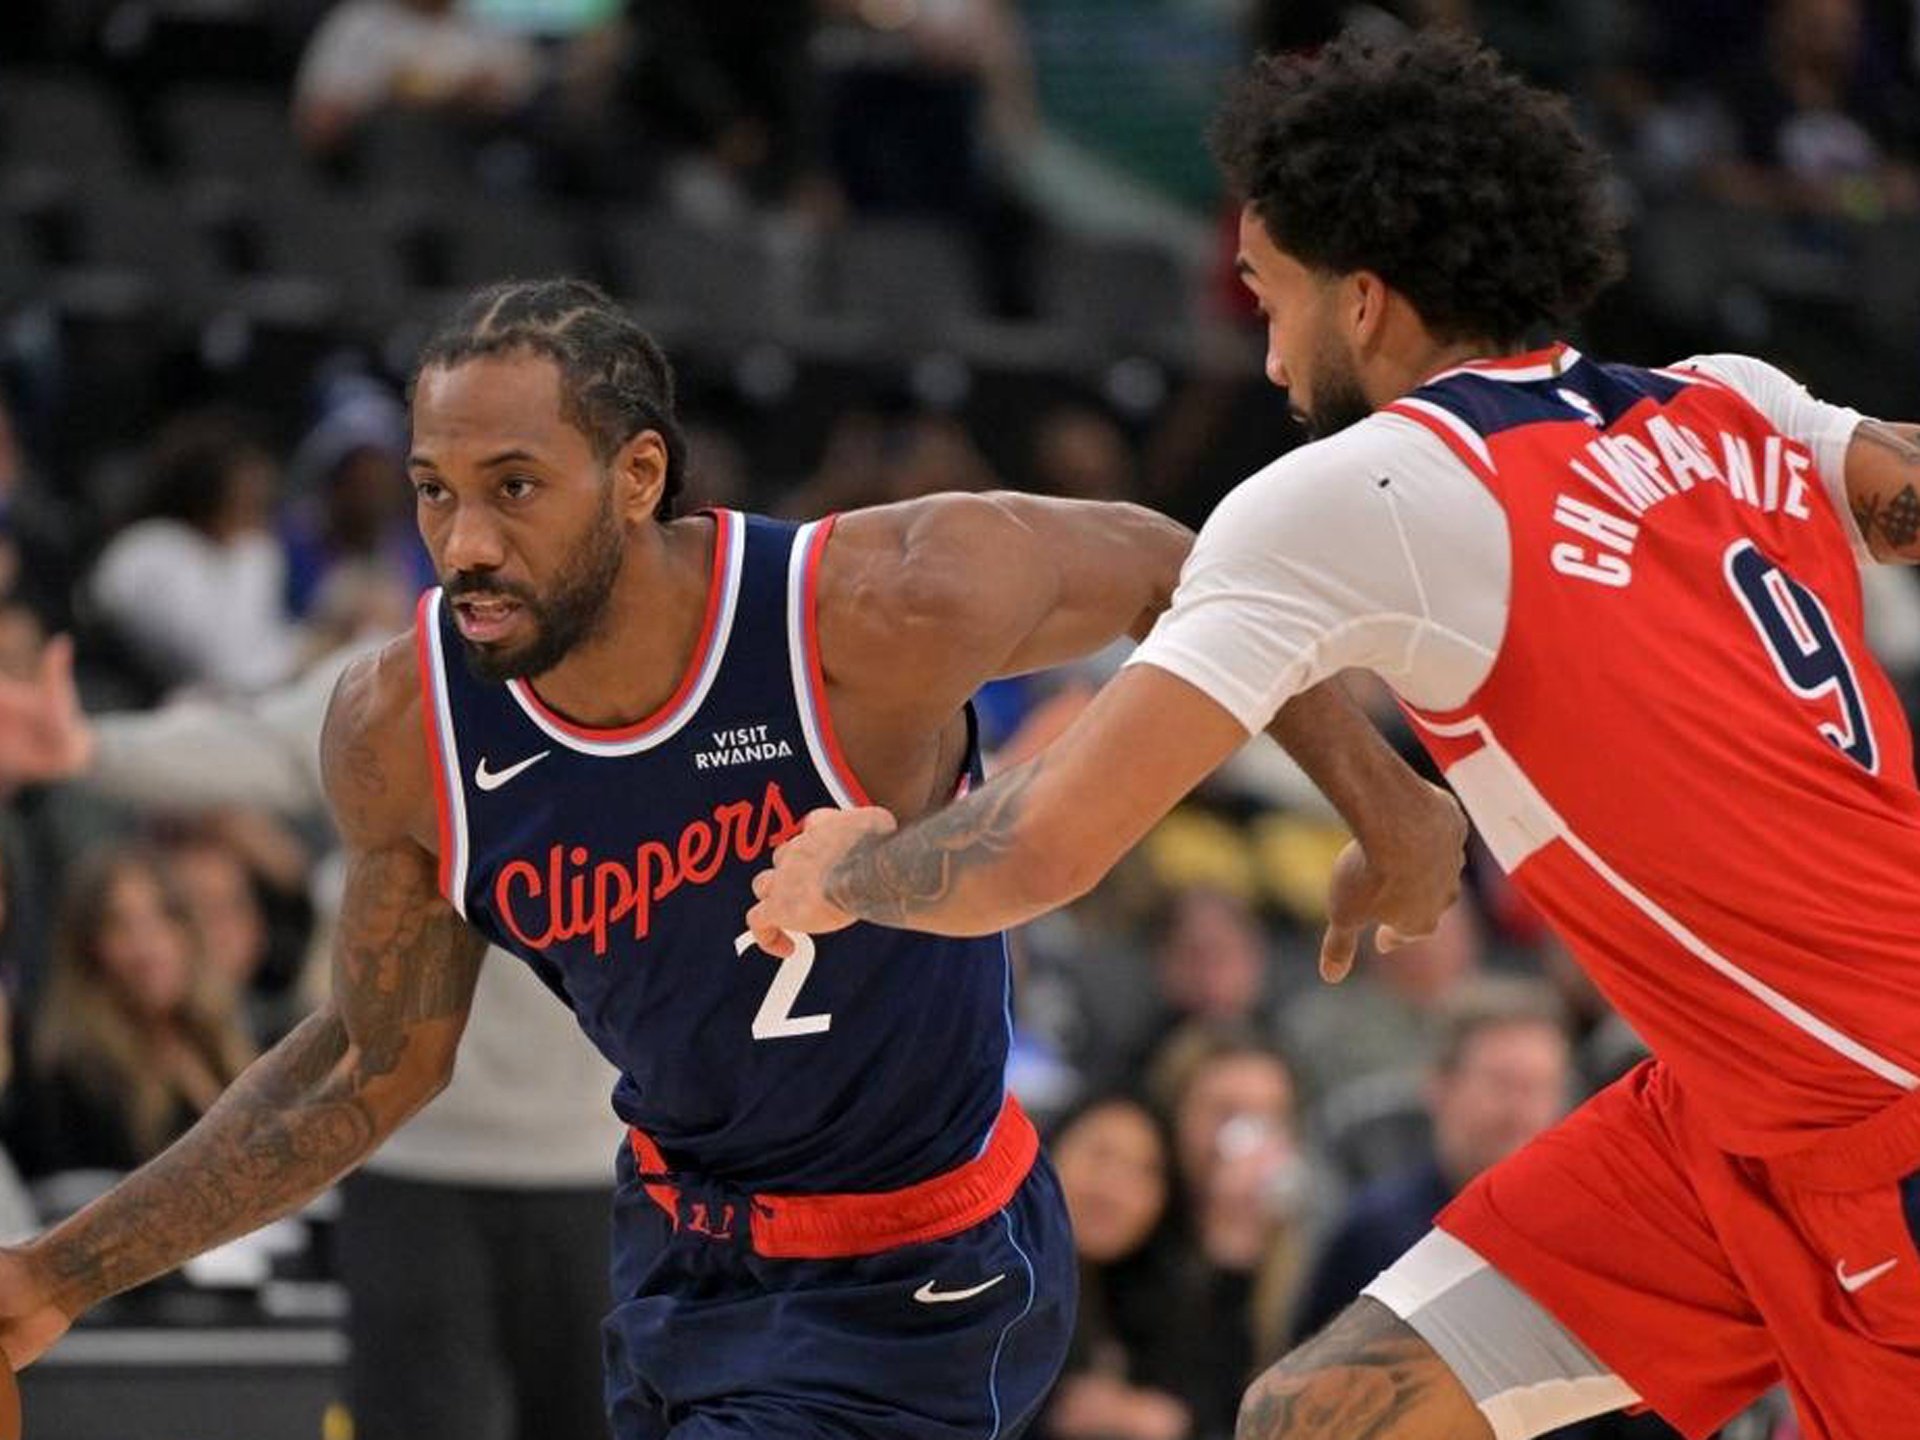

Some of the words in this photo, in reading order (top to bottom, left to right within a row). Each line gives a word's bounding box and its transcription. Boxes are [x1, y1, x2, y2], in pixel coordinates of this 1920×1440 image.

[1723, 537, 1880, 777] 9
[695, 740, 793, 770] RWANDA
[712, 725, 768, 748] VISIT
[496, 781, 804, 957] Clippers
[734, 929, 832, 1040] 2
